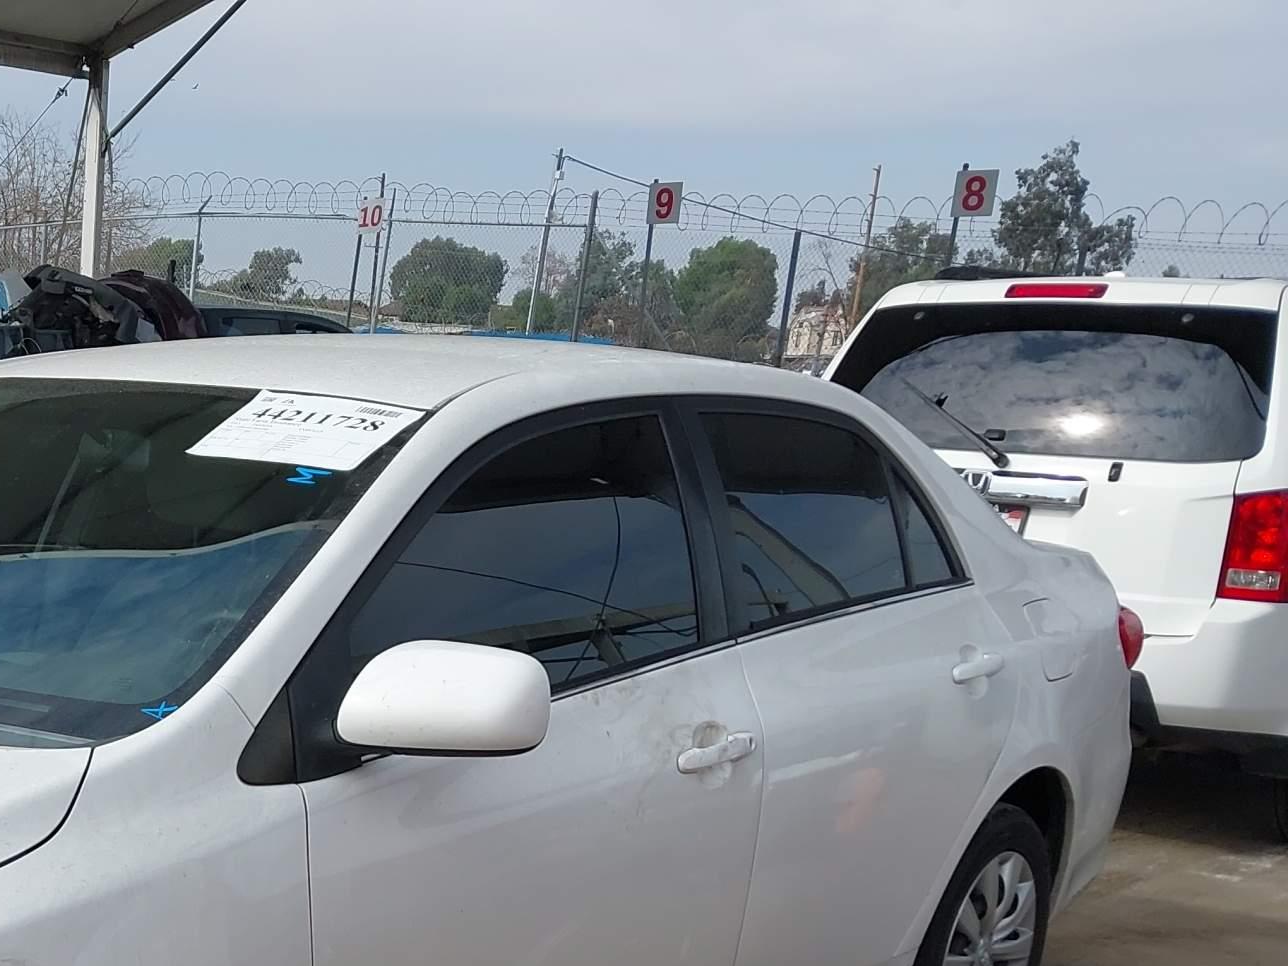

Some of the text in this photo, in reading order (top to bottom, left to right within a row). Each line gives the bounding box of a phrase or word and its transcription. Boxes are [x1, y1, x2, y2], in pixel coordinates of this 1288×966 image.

[655, 187, 675, 219] 9
[961, 175, 988, 212] 8
[359, 205, 382, 227] 10
[252, 407, 385, 432] 44211728
